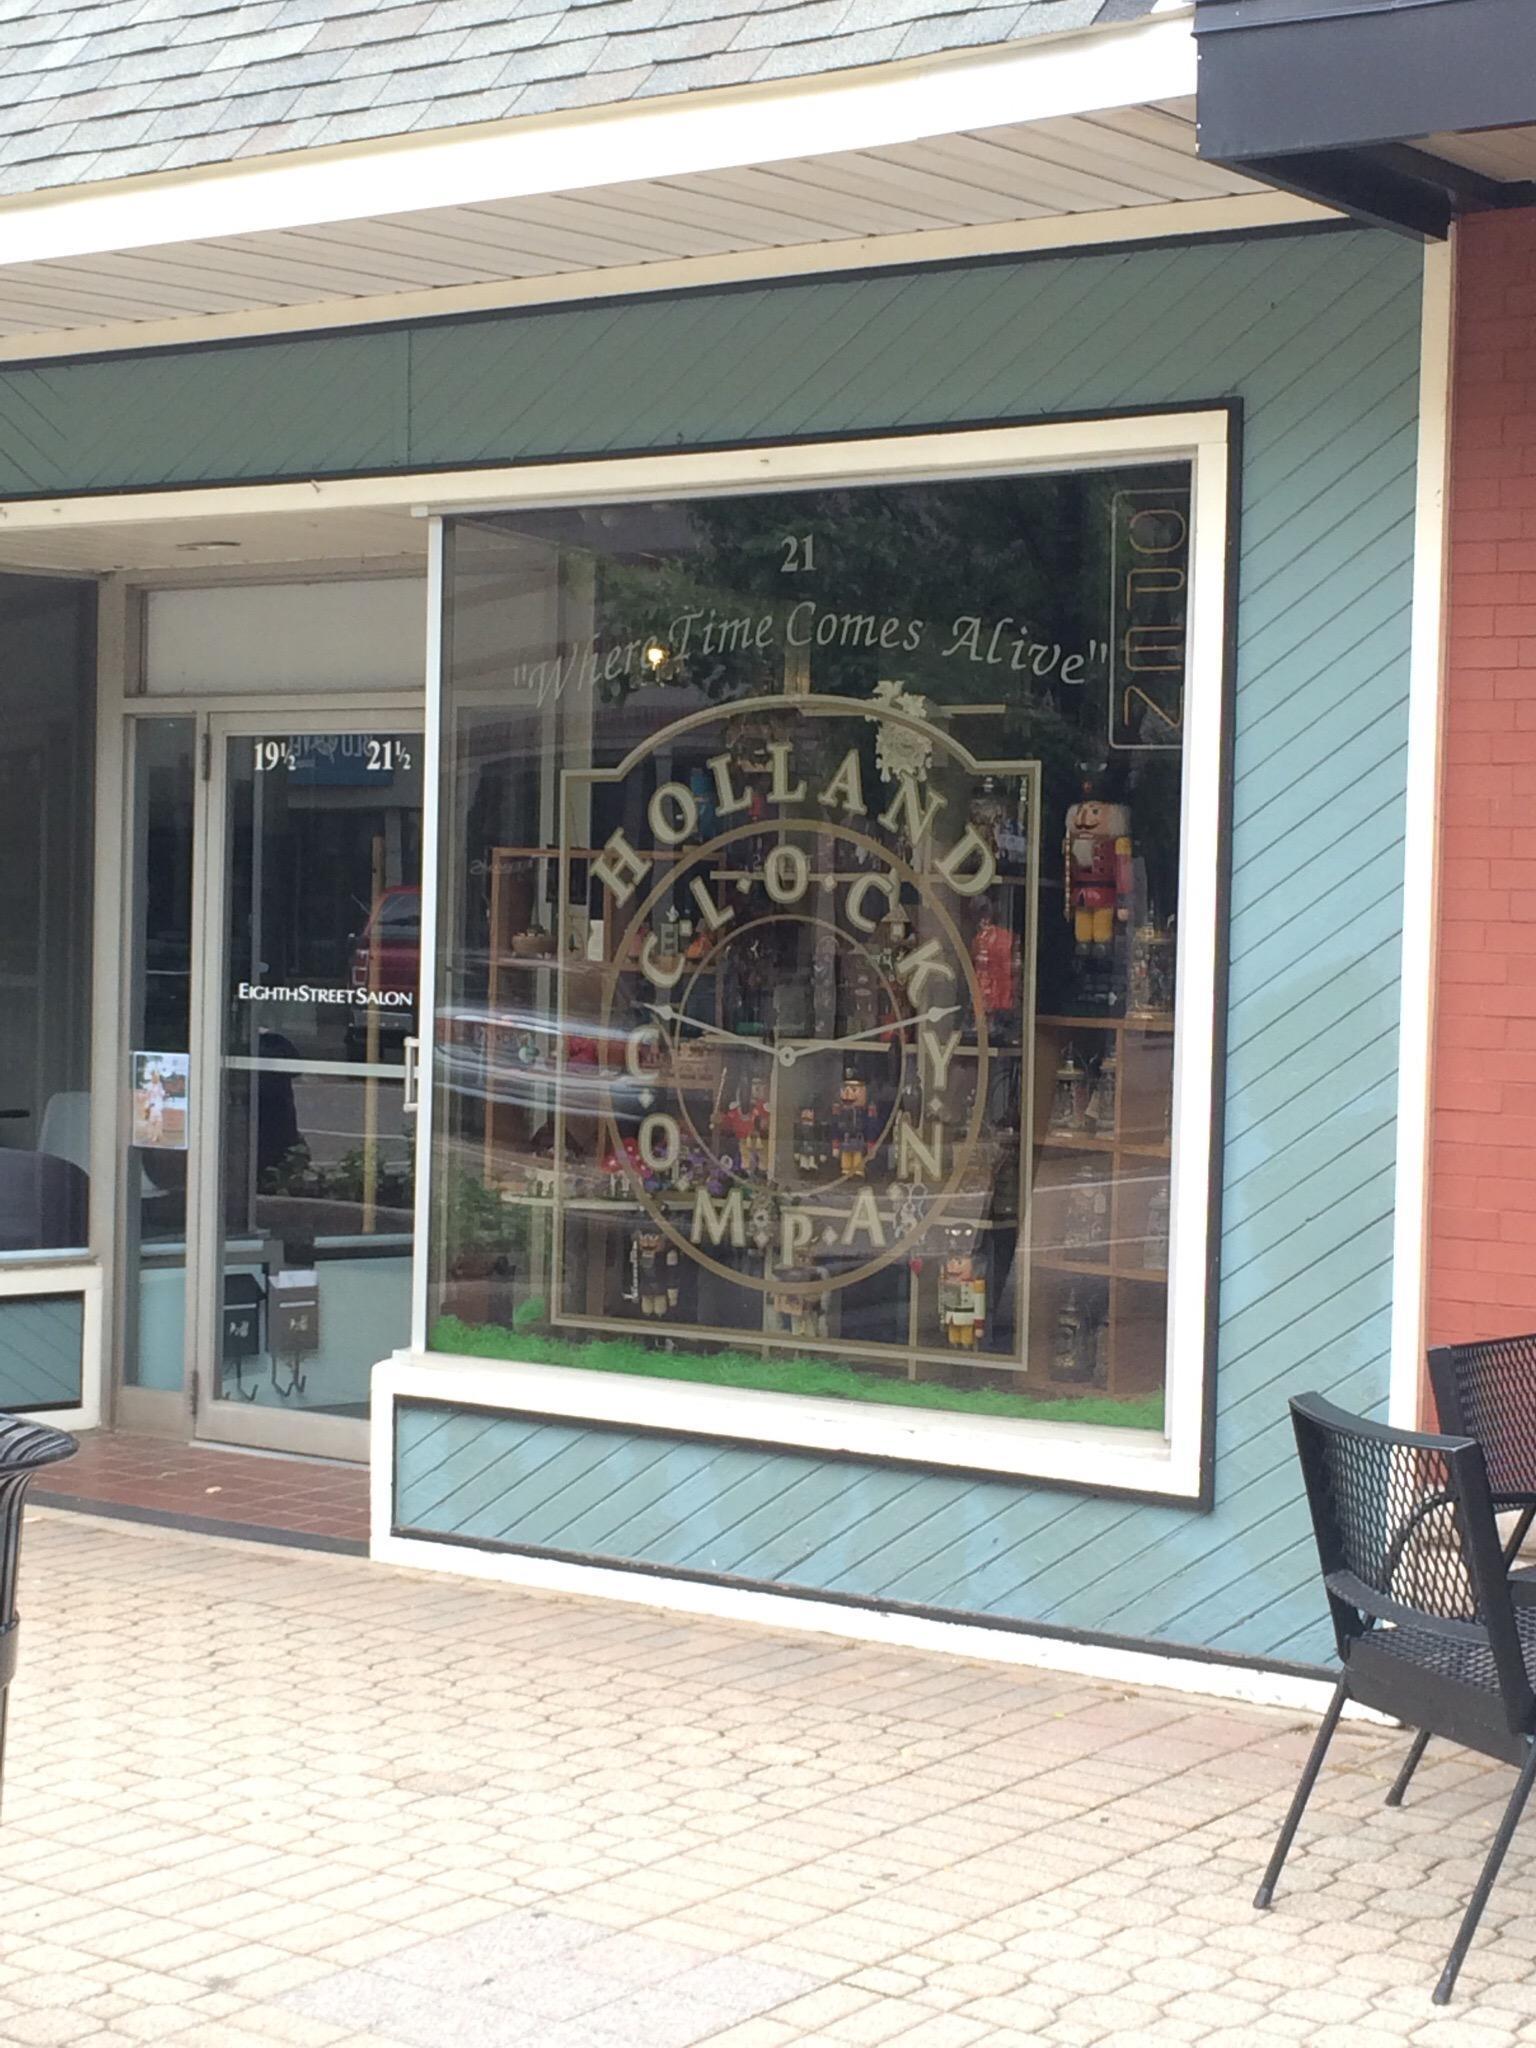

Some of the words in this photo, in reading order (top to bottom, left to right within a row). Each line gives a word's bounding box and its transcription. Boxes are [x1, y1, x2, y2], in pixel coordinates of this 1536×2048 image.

[780, 534, 818, 573] 21
[668, 607, 775, 662] Time
[787, 601, 924, 651] Comes
[1124, 509, 1186, 728] OPEN
[591, 742, 997, 906] HOLLAND
